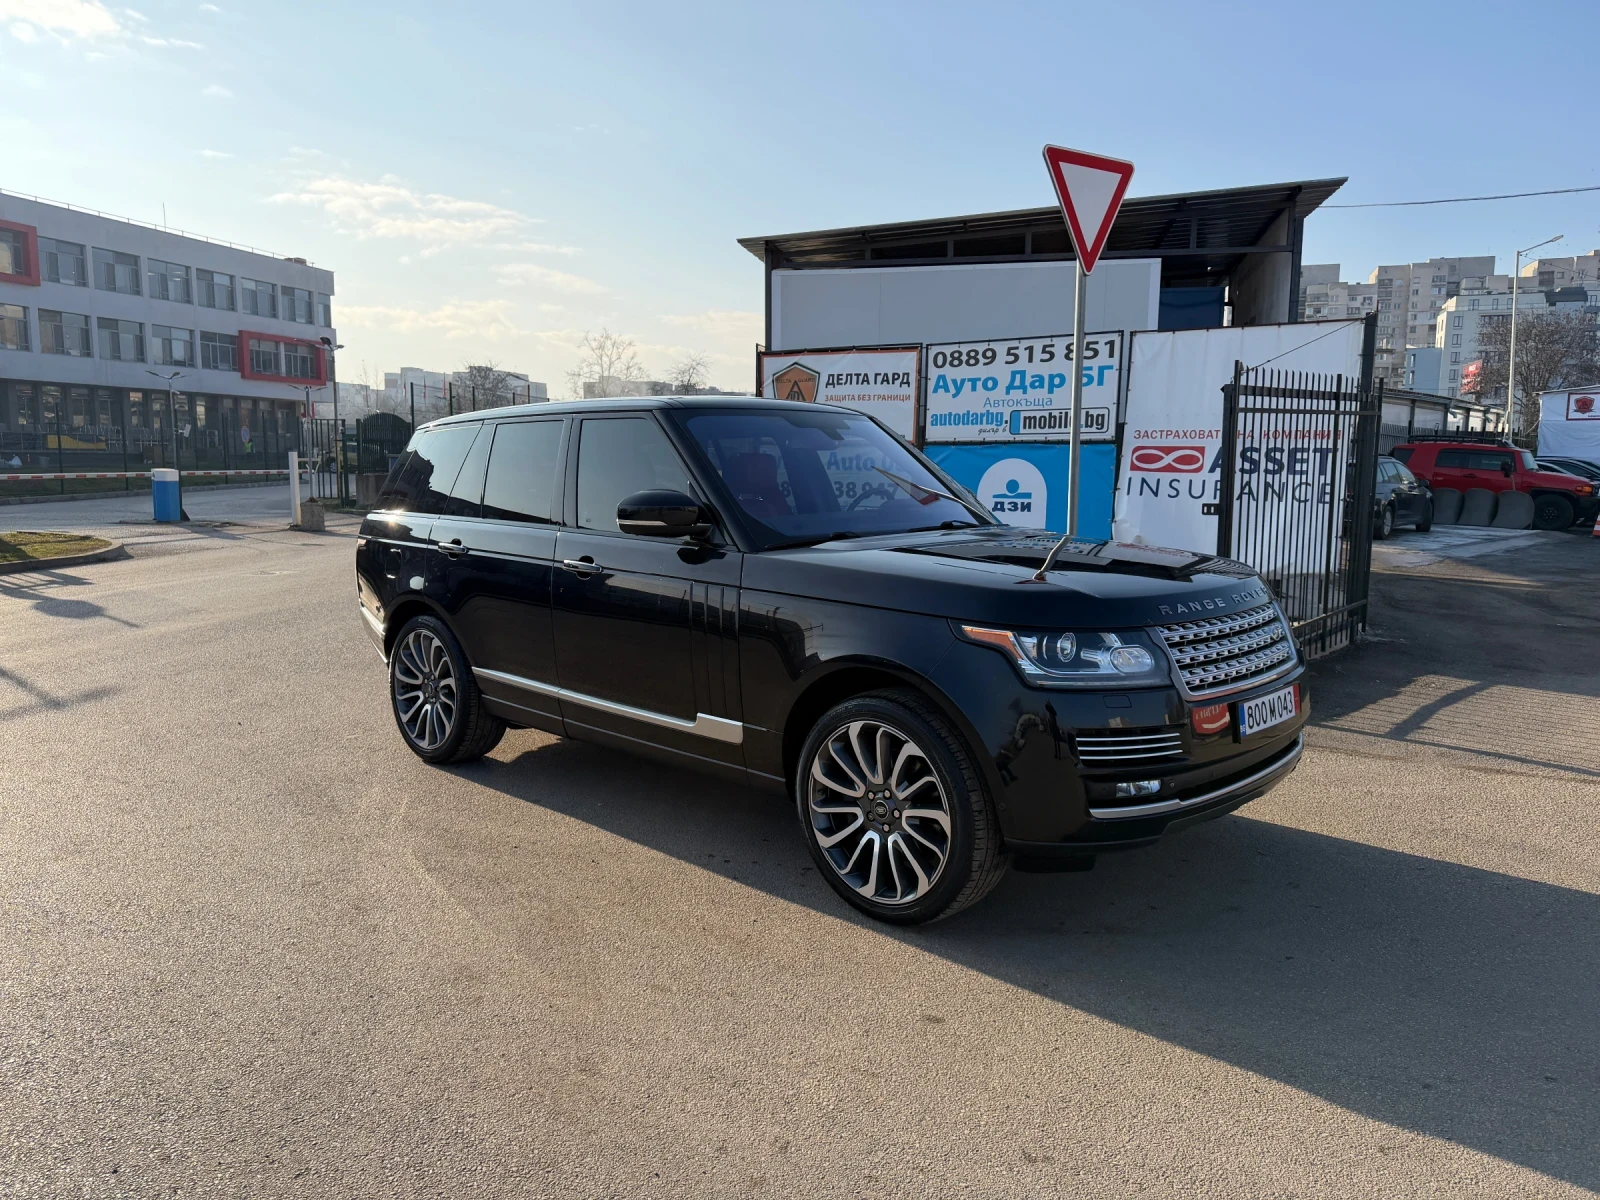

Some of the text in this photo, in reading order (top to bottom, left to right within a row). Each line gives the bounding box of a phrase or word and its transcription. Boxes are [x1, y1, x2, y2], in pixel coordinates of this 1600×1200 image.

[932, 339, 1116, 369] 0889 515 851
[825, 372, 911, 388] ДЕЛТА ГАРД
[931, 373, 999, 399] Ауто
[1005, 369, 1067, 395] Дар
[825, 394, 911, 402] ЗАЩИТА БЕЗ ГРАНИЦИ
[983, 397, 1053, 409] Автокъща
[826, 451, 876, 472] Auto
[992, 501, 1032, 512] ДЗИ
[1158, 586, 1268, 615] RANGE ROVER
